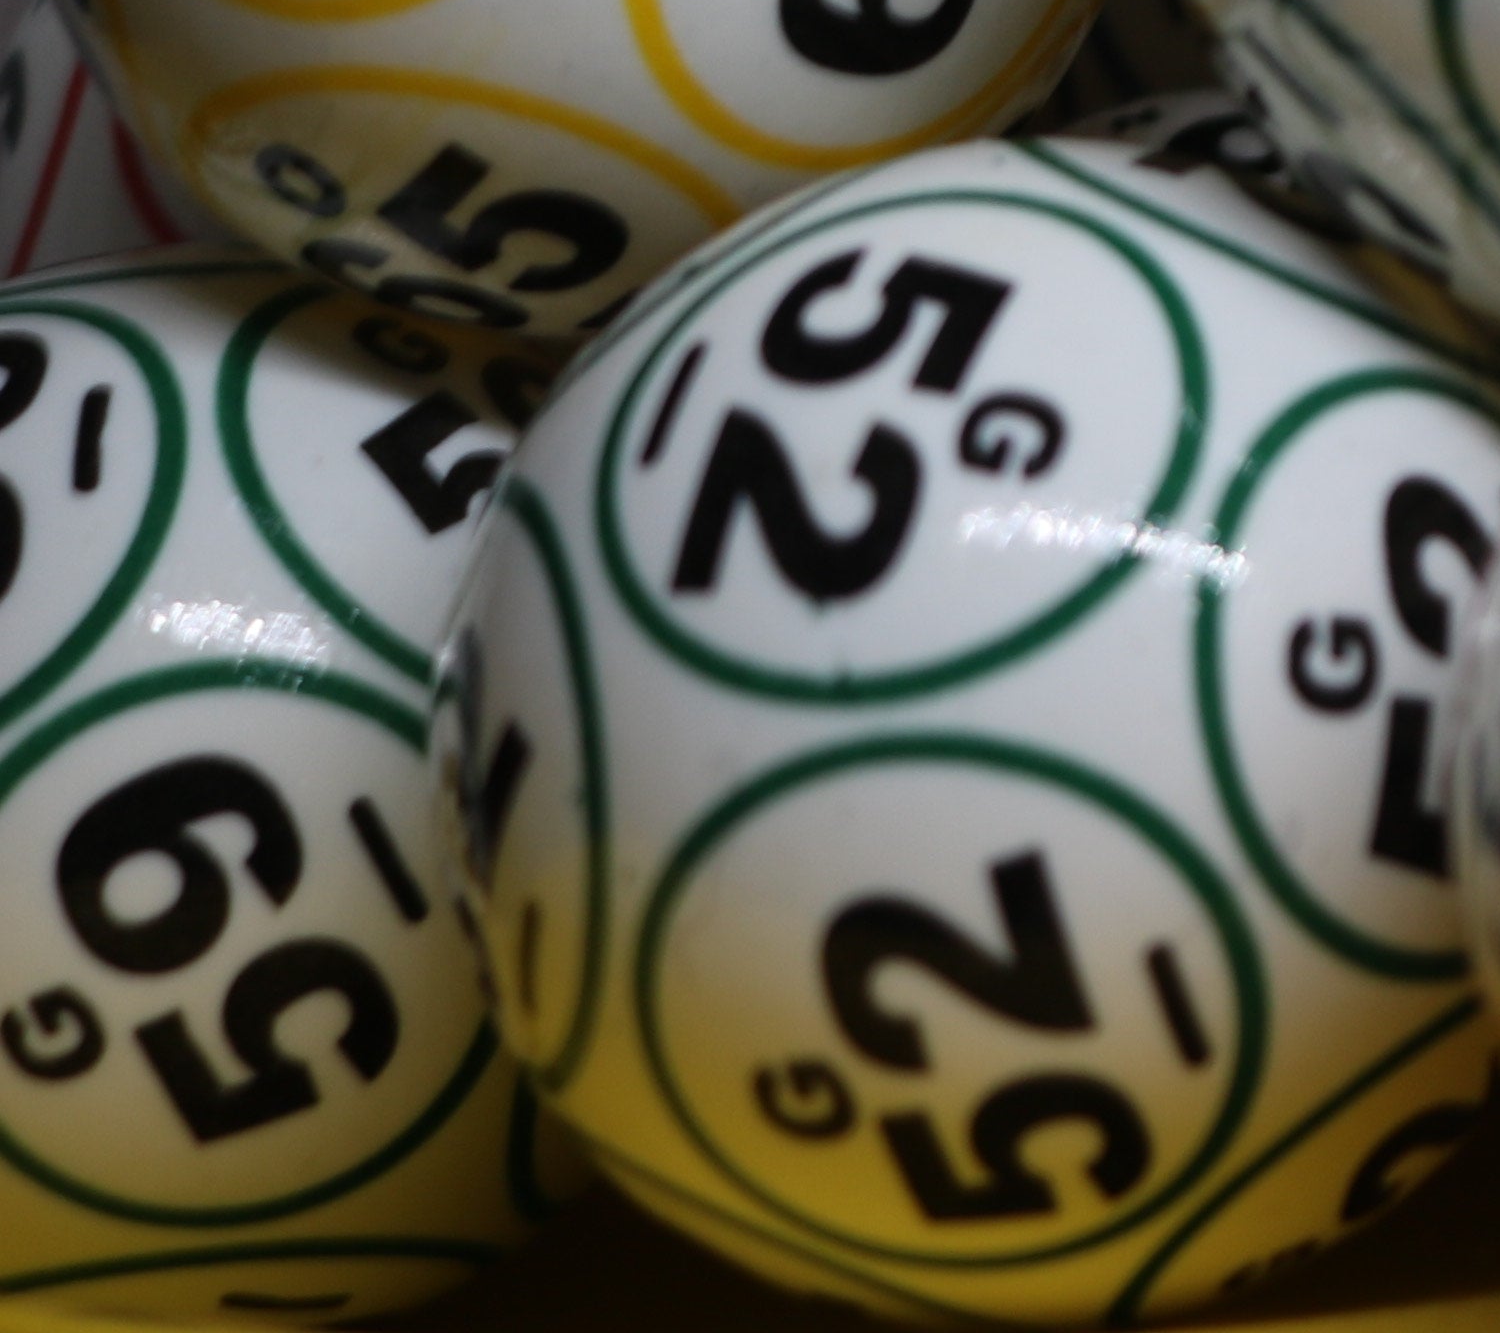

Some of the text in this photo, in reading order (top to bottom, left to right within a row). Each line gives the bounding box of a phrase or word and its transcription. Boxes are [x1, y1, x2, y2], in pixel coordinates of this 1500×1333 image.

[670, 245, 1019, 609] 52
[955, 391, 1069, 484] G
[1286, 612, 1382, 716] G
[55, 750, 401, 1151] 59
[2, 983, 107, 1084] G
[818, 845, 1156, 1225] 52
[752, 1057, 861, 1142] G
